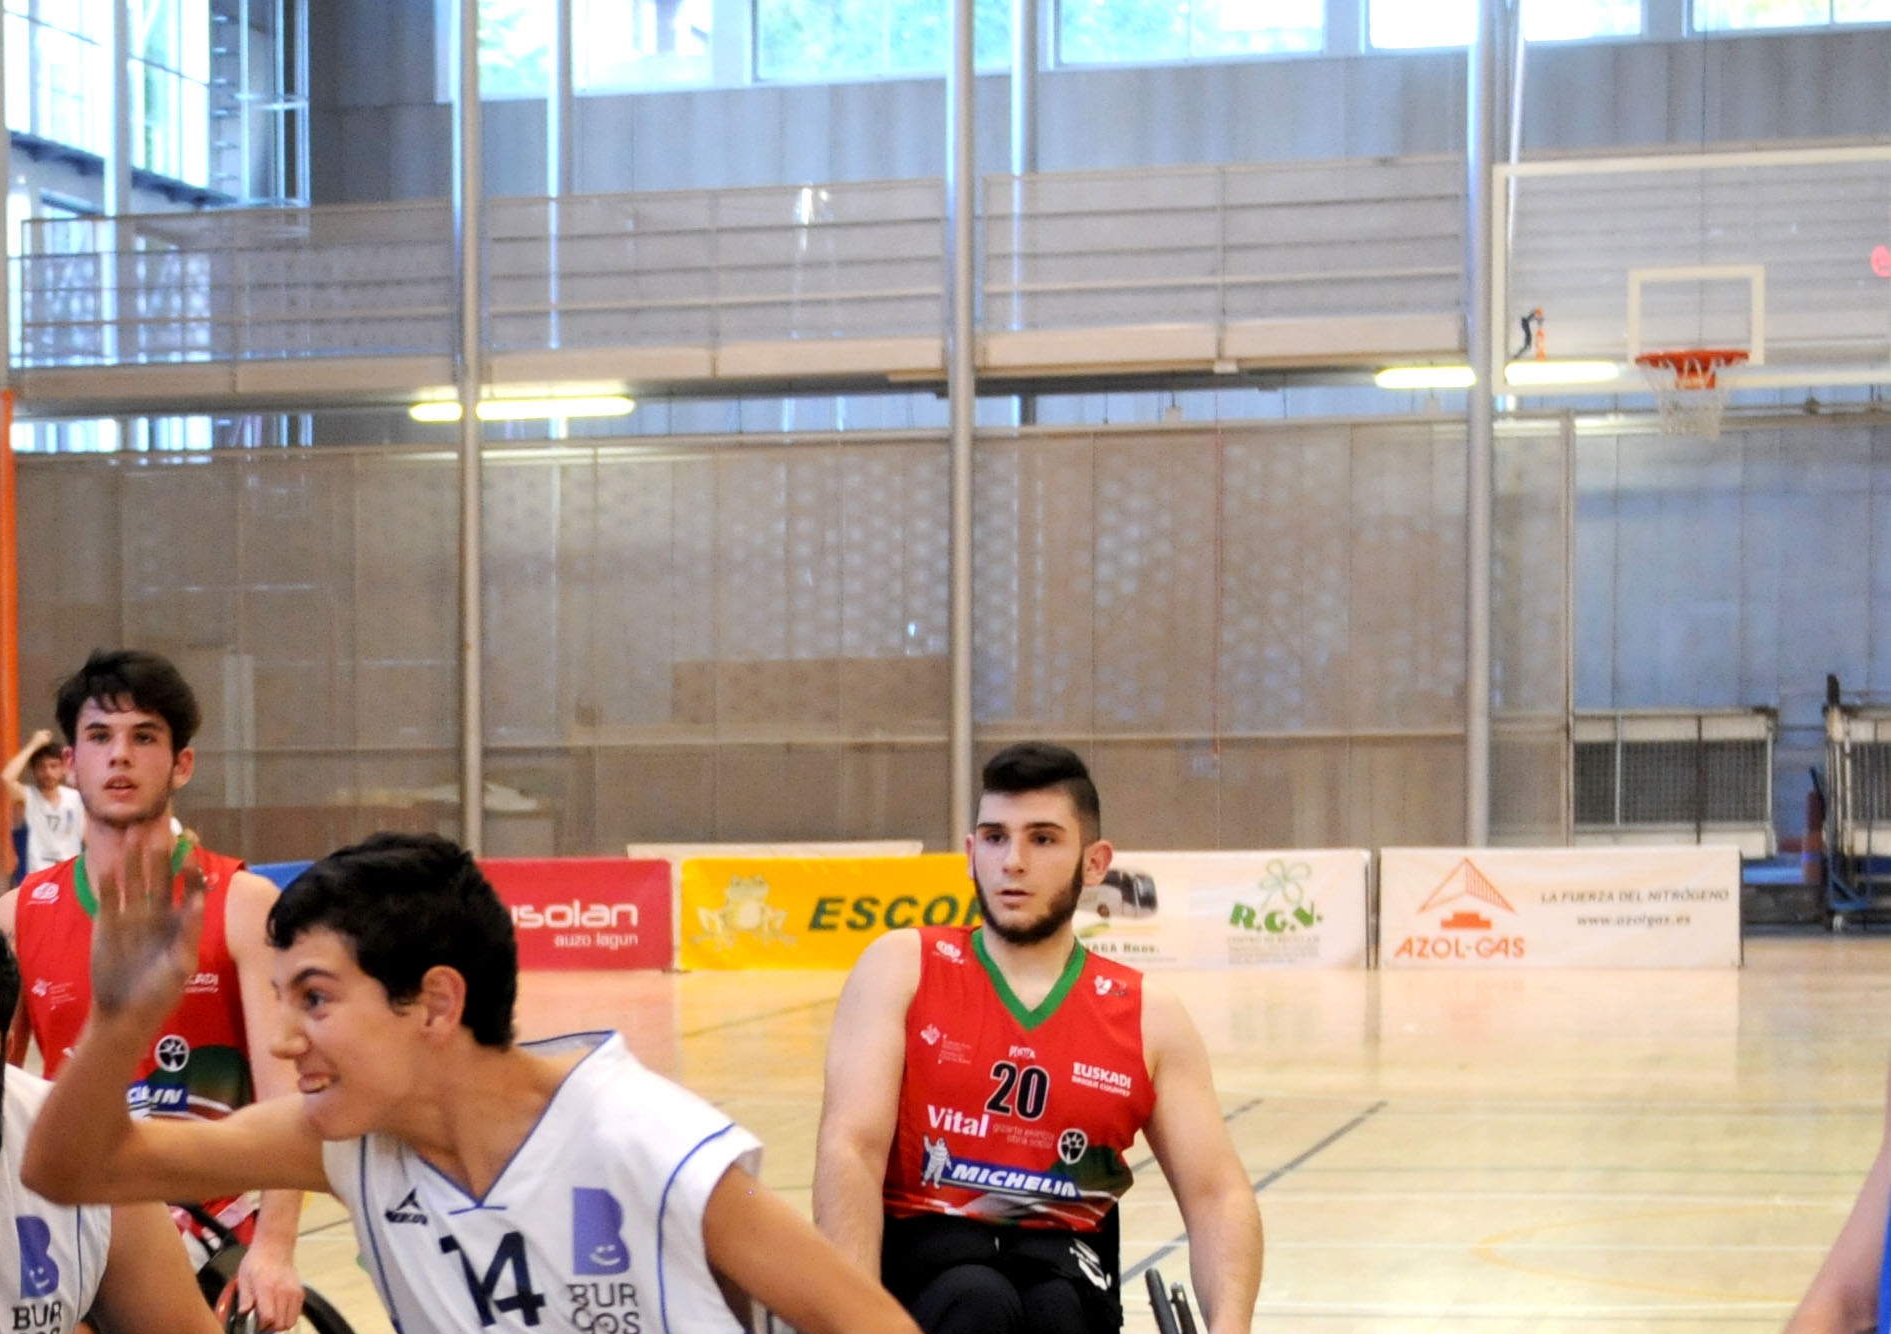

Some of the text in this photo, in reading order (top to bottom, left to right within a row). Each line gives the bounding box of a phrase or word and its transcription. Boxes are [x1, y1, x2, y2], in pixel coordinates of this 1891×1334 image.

[1561, 889, 1615, 904] FUERZA
[1618, 889, 1643, 903] DEL
[554, 931, 639, 950] auzo lagun
[1393, 936, 1527, 960] AZOL-GAS
[1072, 1061, 1132, 1089] EUSKADI
[984, 1060, 1050, 1121] 20
[926, 1103, 990, 1138] Vital
[950, 1163, 1078, 1198] MICHELIN
[438, 1230, 547, 1328] 14
[565, 1282, 640, 1309] BUR
[11, 1300, 62, 1331] BUR
